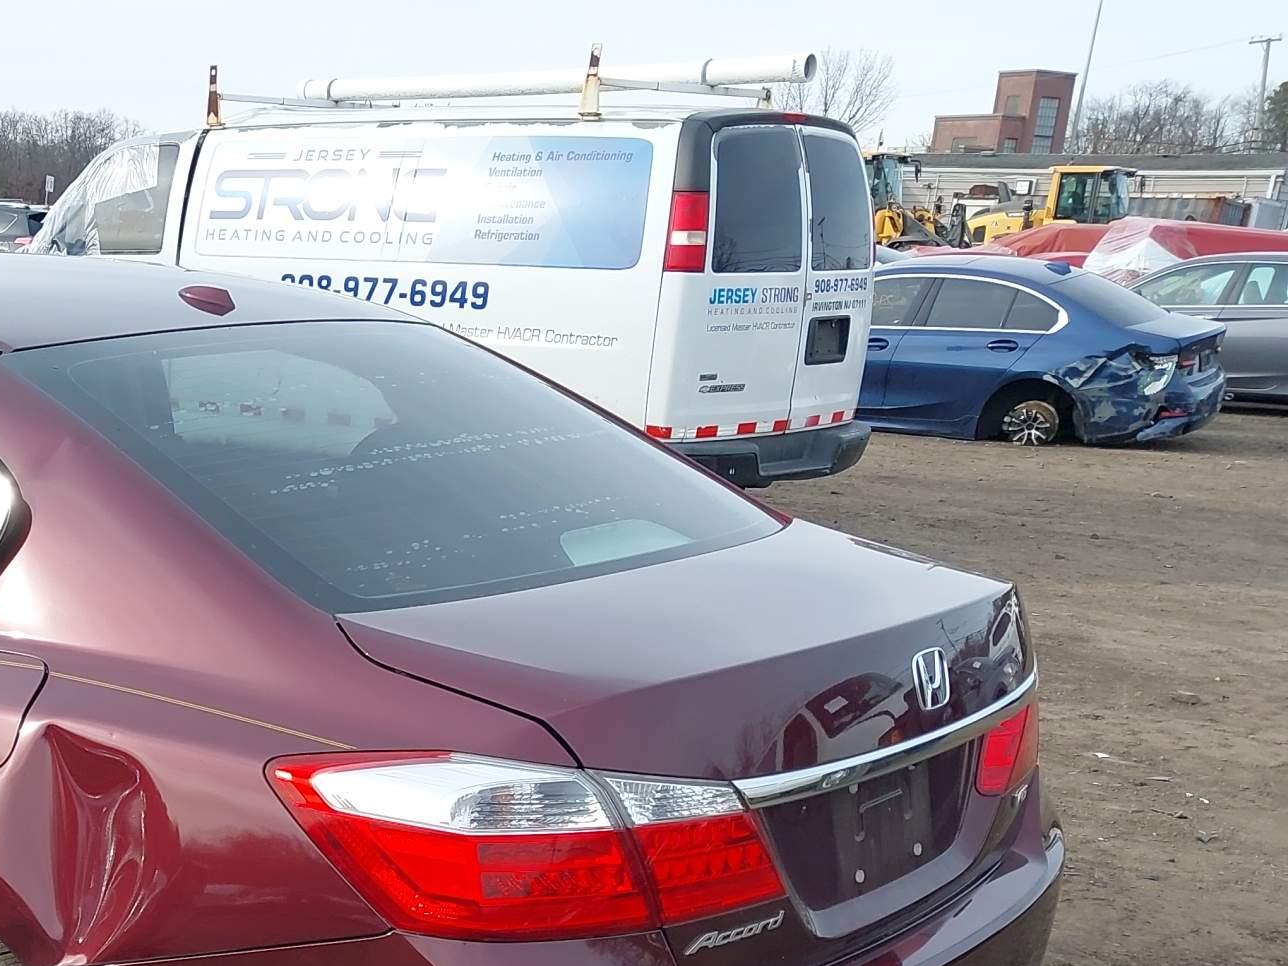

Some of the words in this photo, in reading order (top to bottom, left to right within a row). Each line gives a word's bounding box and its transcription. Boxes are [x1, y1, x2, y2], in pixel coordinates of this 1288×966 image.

[293, 149, 371, 161] JERSEY
[492, 151, 531, 163] Heating
[535, 151, 543, 161] &
[547, 150, 563, 161] Air
[566, 150, 633, 162] Conditioning
[488, 167, 543, 177] Ventilation
[477, 214, 534, 225] Installation
[205, 228, 286, 242] HEATING
[292, 229, 332, 243] AND
[339, 230, 433, 245] COOLING
[474, 229, 540, 242] Refrigeration
[814, 277, 867, 293] 908-977-6949
[709, 287, 758, 304] JERSEY
[761, 287, 799, 304] STRONG
[707, 307, 745, 316] HEATING
[747, 307, 763, 315] AND
[812, 301, 843, 312] IRVINGTON
[497, 326, 541, 342] HVACR
[545, 329, 618, 347] Contractor
[684, 910, 785, 956] Accord
